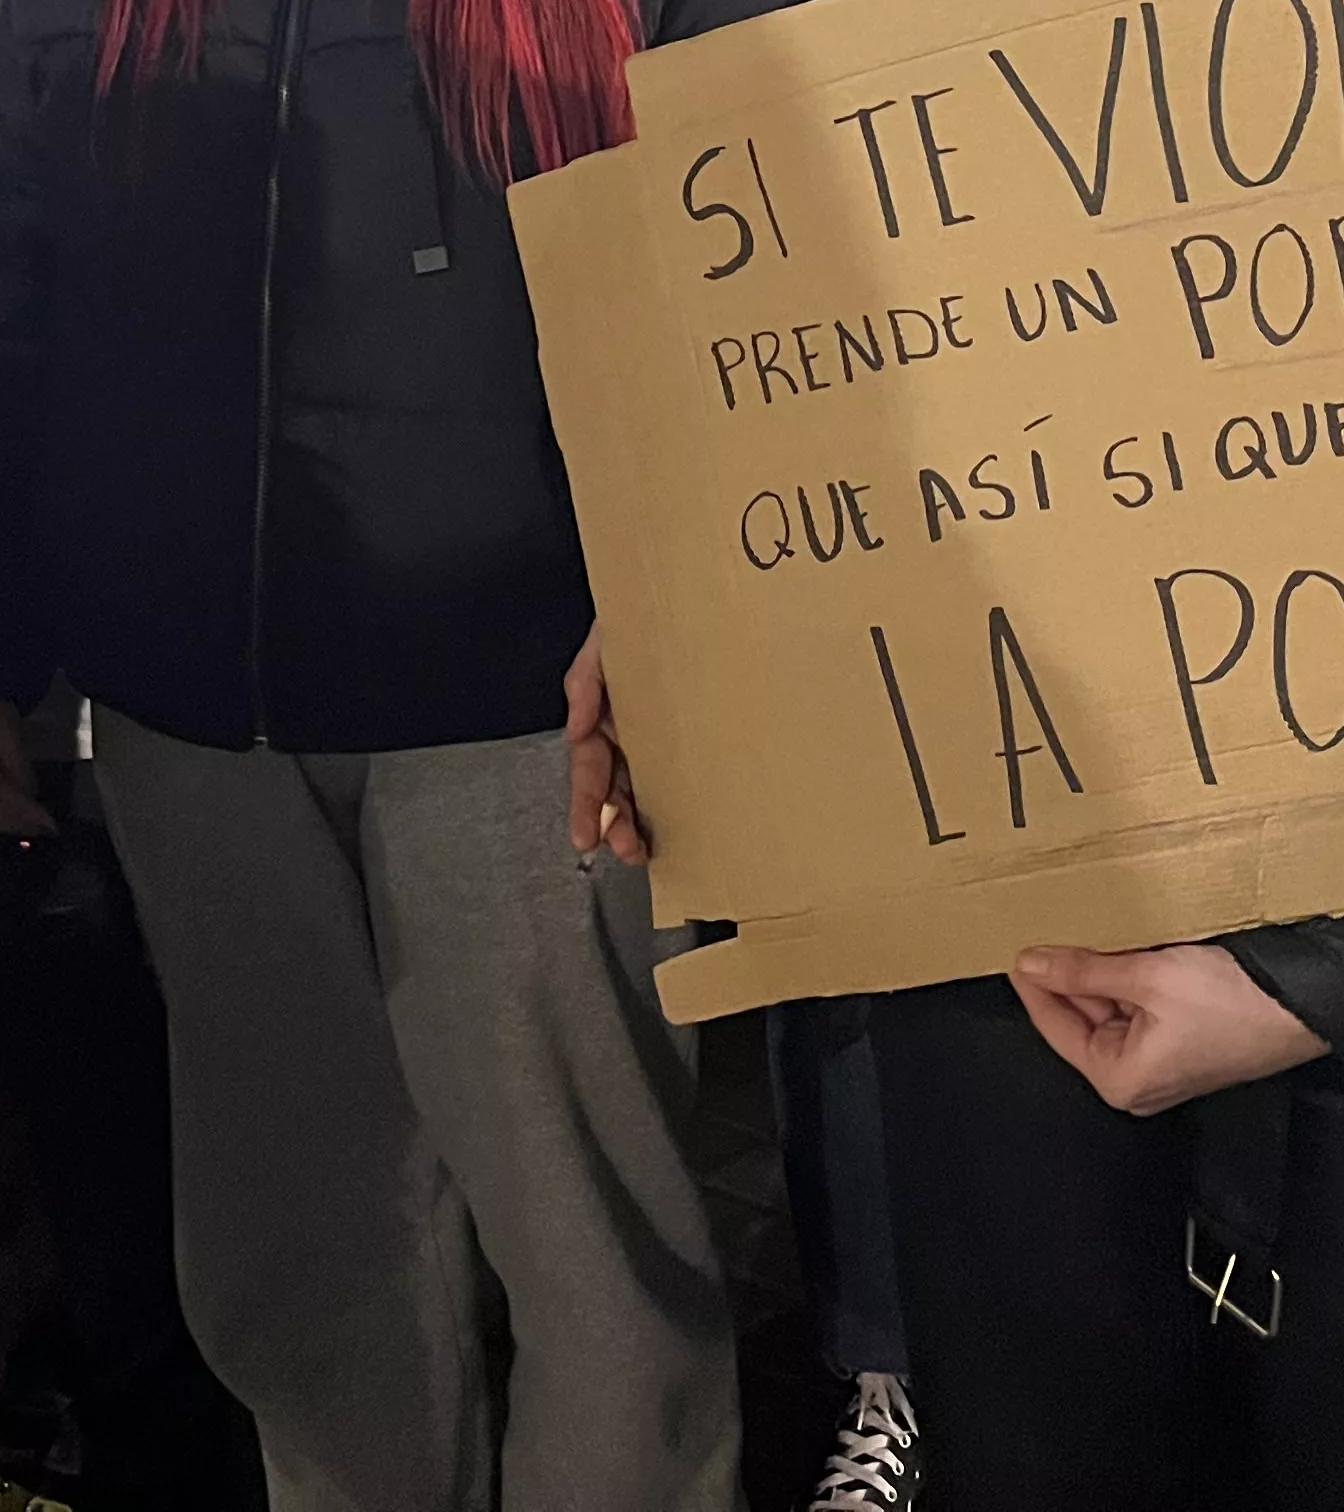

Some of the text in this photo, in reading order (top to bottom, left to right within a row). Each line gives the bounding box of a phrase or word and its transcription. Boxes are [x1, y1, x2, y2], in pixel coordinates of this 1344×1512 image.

[682, 138, 788, 280] SI
[832, 88, 976, 240] TE
[710, 295, 975, 411] PRENDE
[1004, 267, 1119, 343] UN
[741, 479, 886, 572] QUE
[921, 418, 1054, 543] ASÍ
[1103, 431, 1184, 510] SI
[868, 606, 1085, 846] LA
